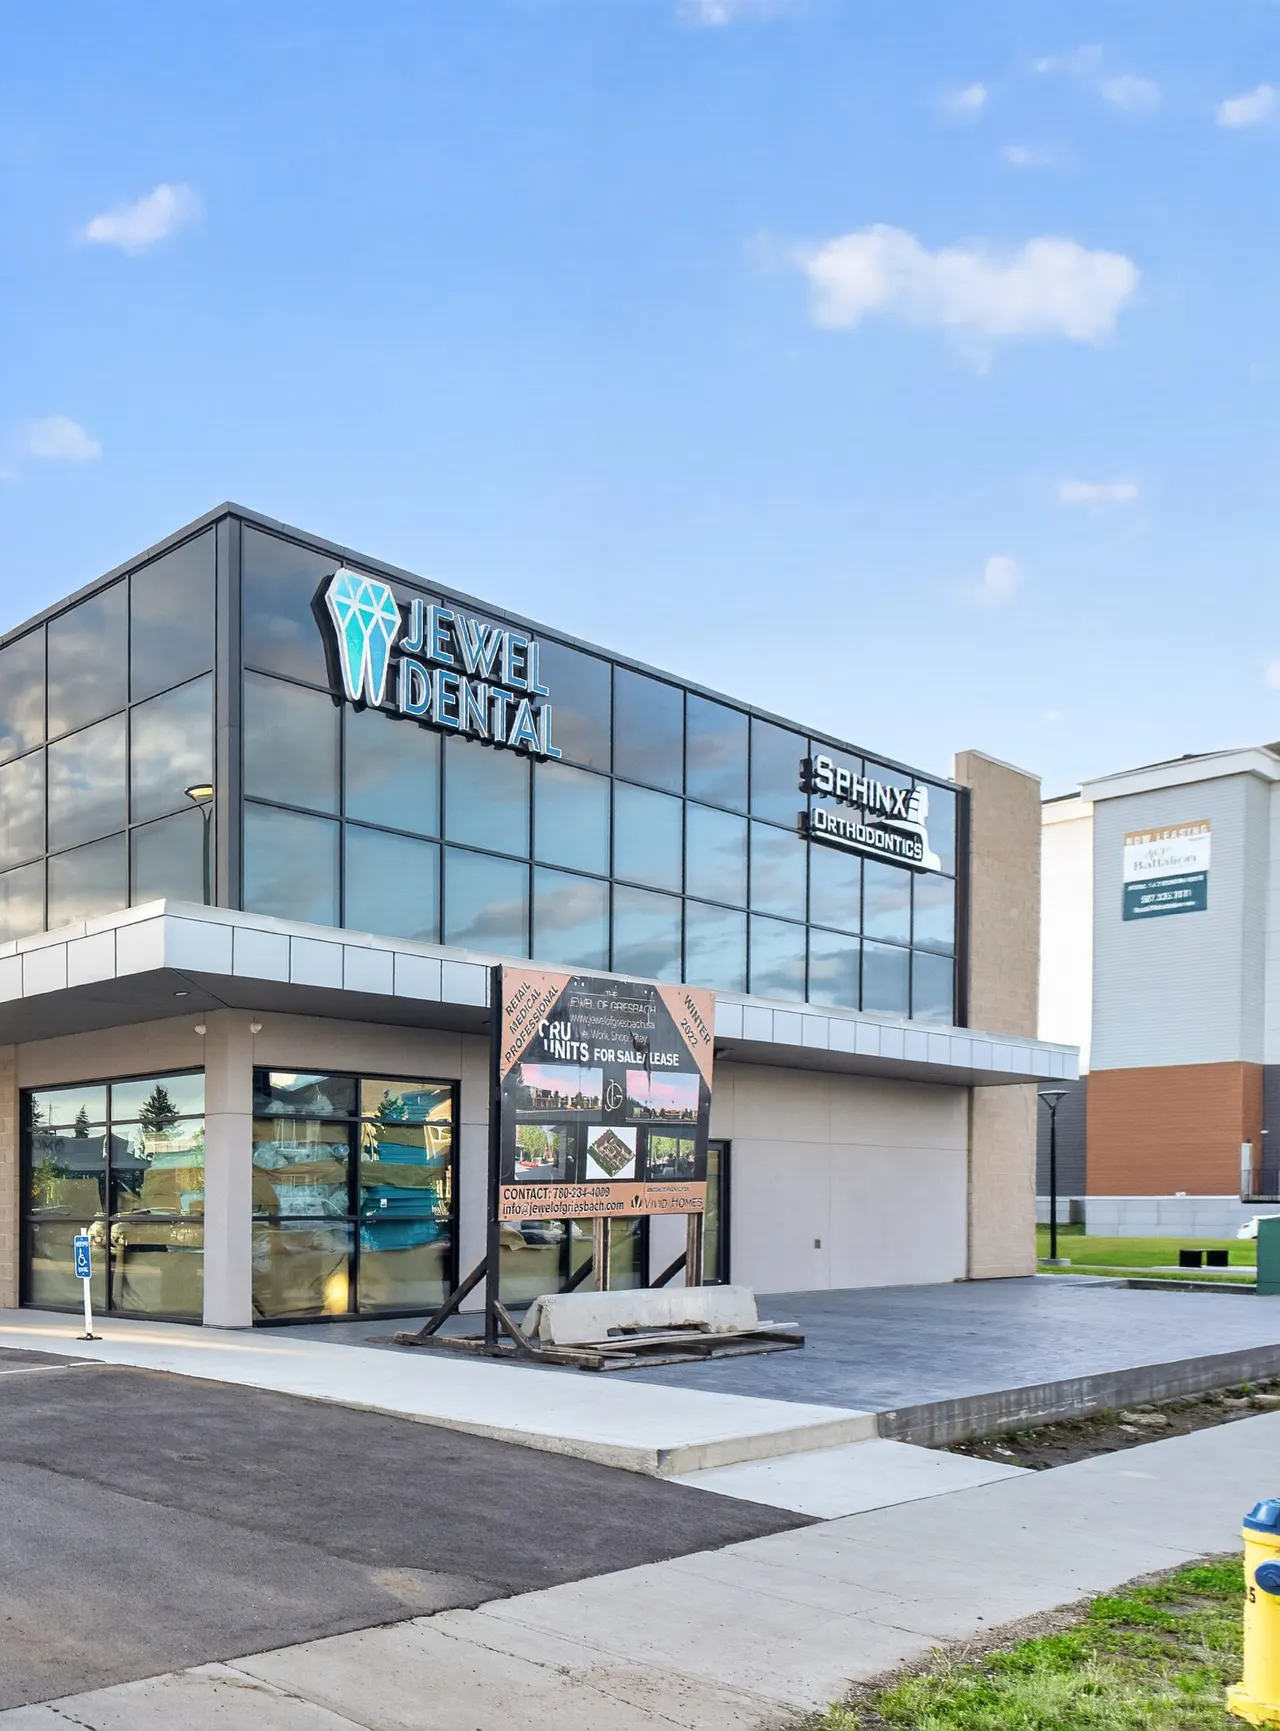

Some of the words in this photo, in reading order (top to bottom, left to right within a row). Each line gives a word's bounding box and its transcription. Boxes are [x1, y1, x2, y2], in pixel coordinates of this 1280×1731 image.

[399, 598, 549, 696] JEWEL
[399, 656, 562, 758] DENTAL
[814, 754, 908, 818] SPHINX
[813, 807, 923, 860] ORTHODONTICS
[506, 981, 531, 1016] RETAIL
[509, 989, 541, 1034] MEDICAL
[505, 985, 558, 1063] PROFESSIONAL
[538, 1018, 572, 1041] CRU
[681, 1017, 699, 1048] 2022
[684, 994, 711, 1046] WINTER
[593, 1048, 615, 1062] FOR
[650, 1052, 680, 1066] LEASE
[502, 1201, 625, 1216] info@jewelofgriesbach.com
[503, 1188, 551, 1200] CONTACT:
[671, 1197, 704, 1208] HOMES
